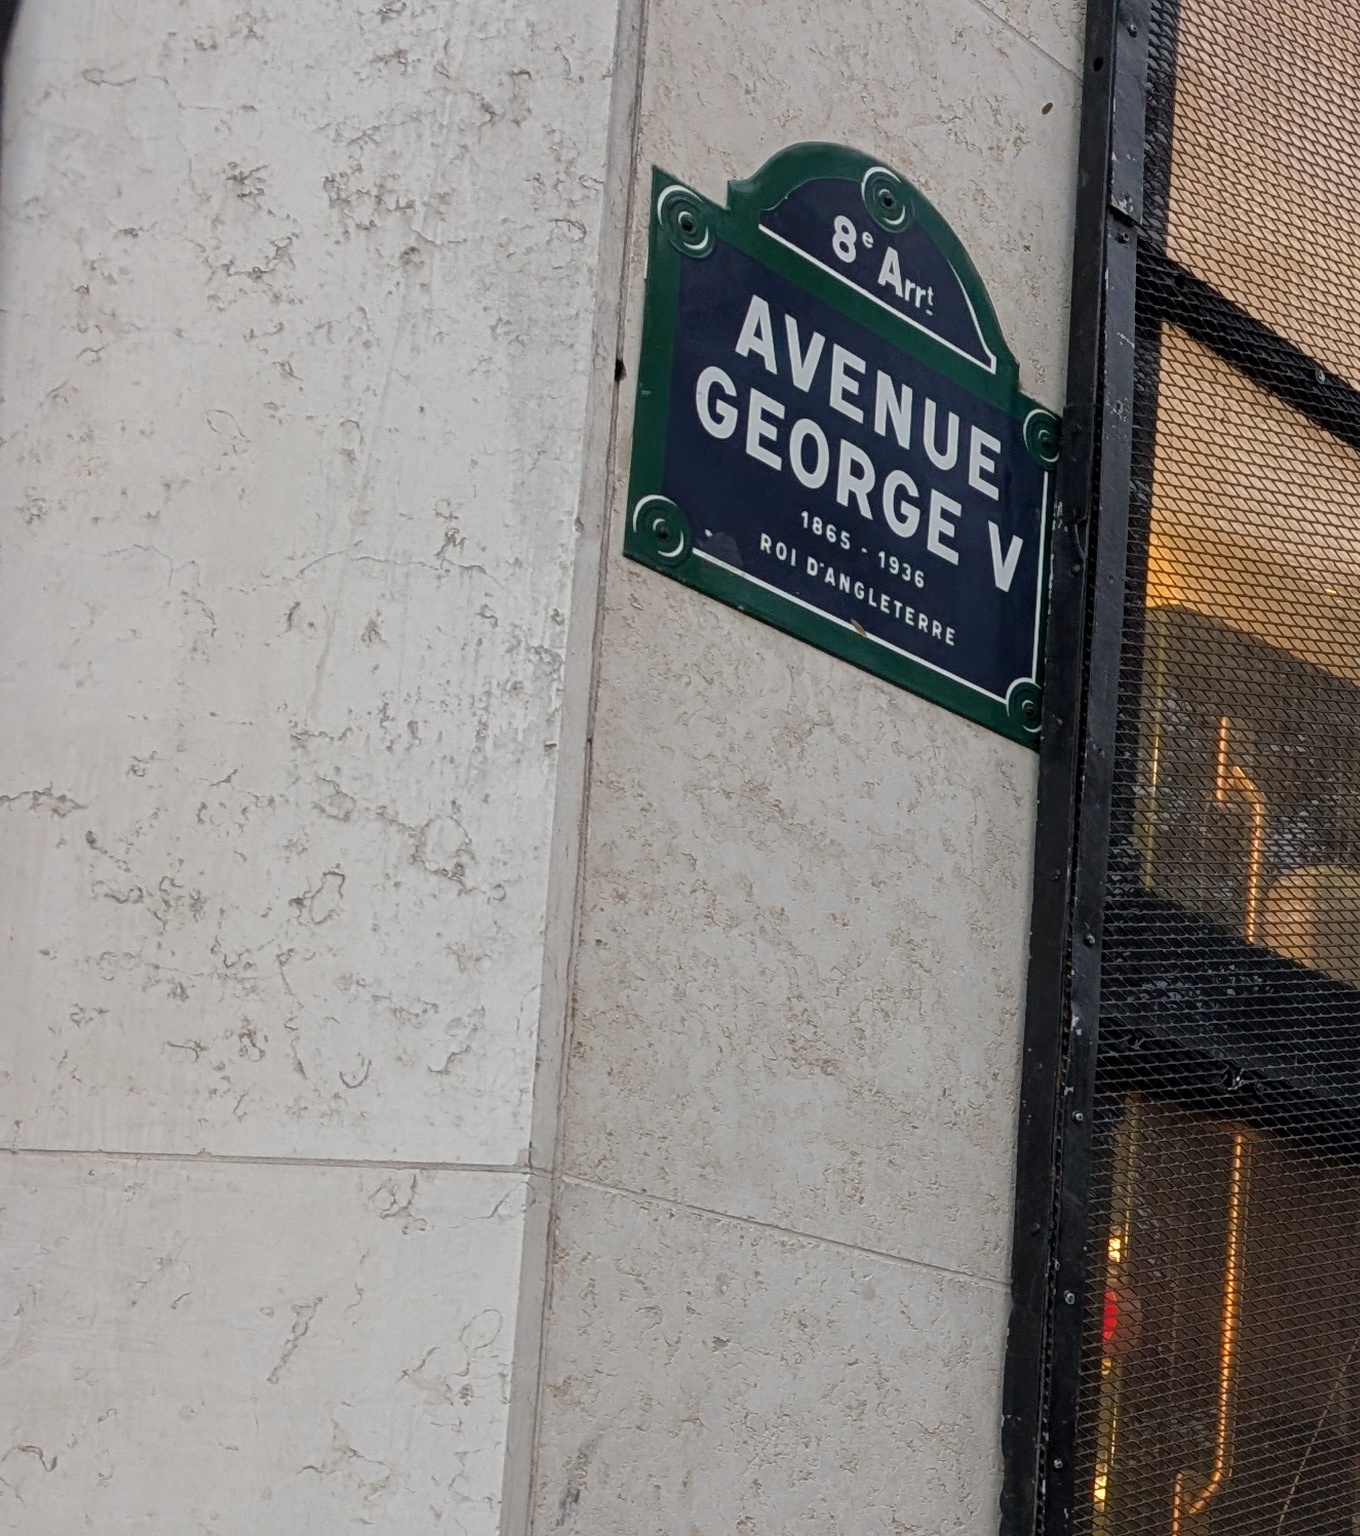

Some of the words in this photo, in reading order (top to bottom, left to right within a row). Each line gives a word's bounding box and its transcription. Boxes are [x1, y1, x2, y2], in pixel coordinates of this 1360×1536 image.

[734, 294, 1002, 502] AVENUE
[695, 365, 962, 566] GEORGE
[988, 519, 1024, 593] V
[759, 532, 797, 568] ROI
[800, 510, 852, 551] 1865
[877, 549, 926, 588] 1936
